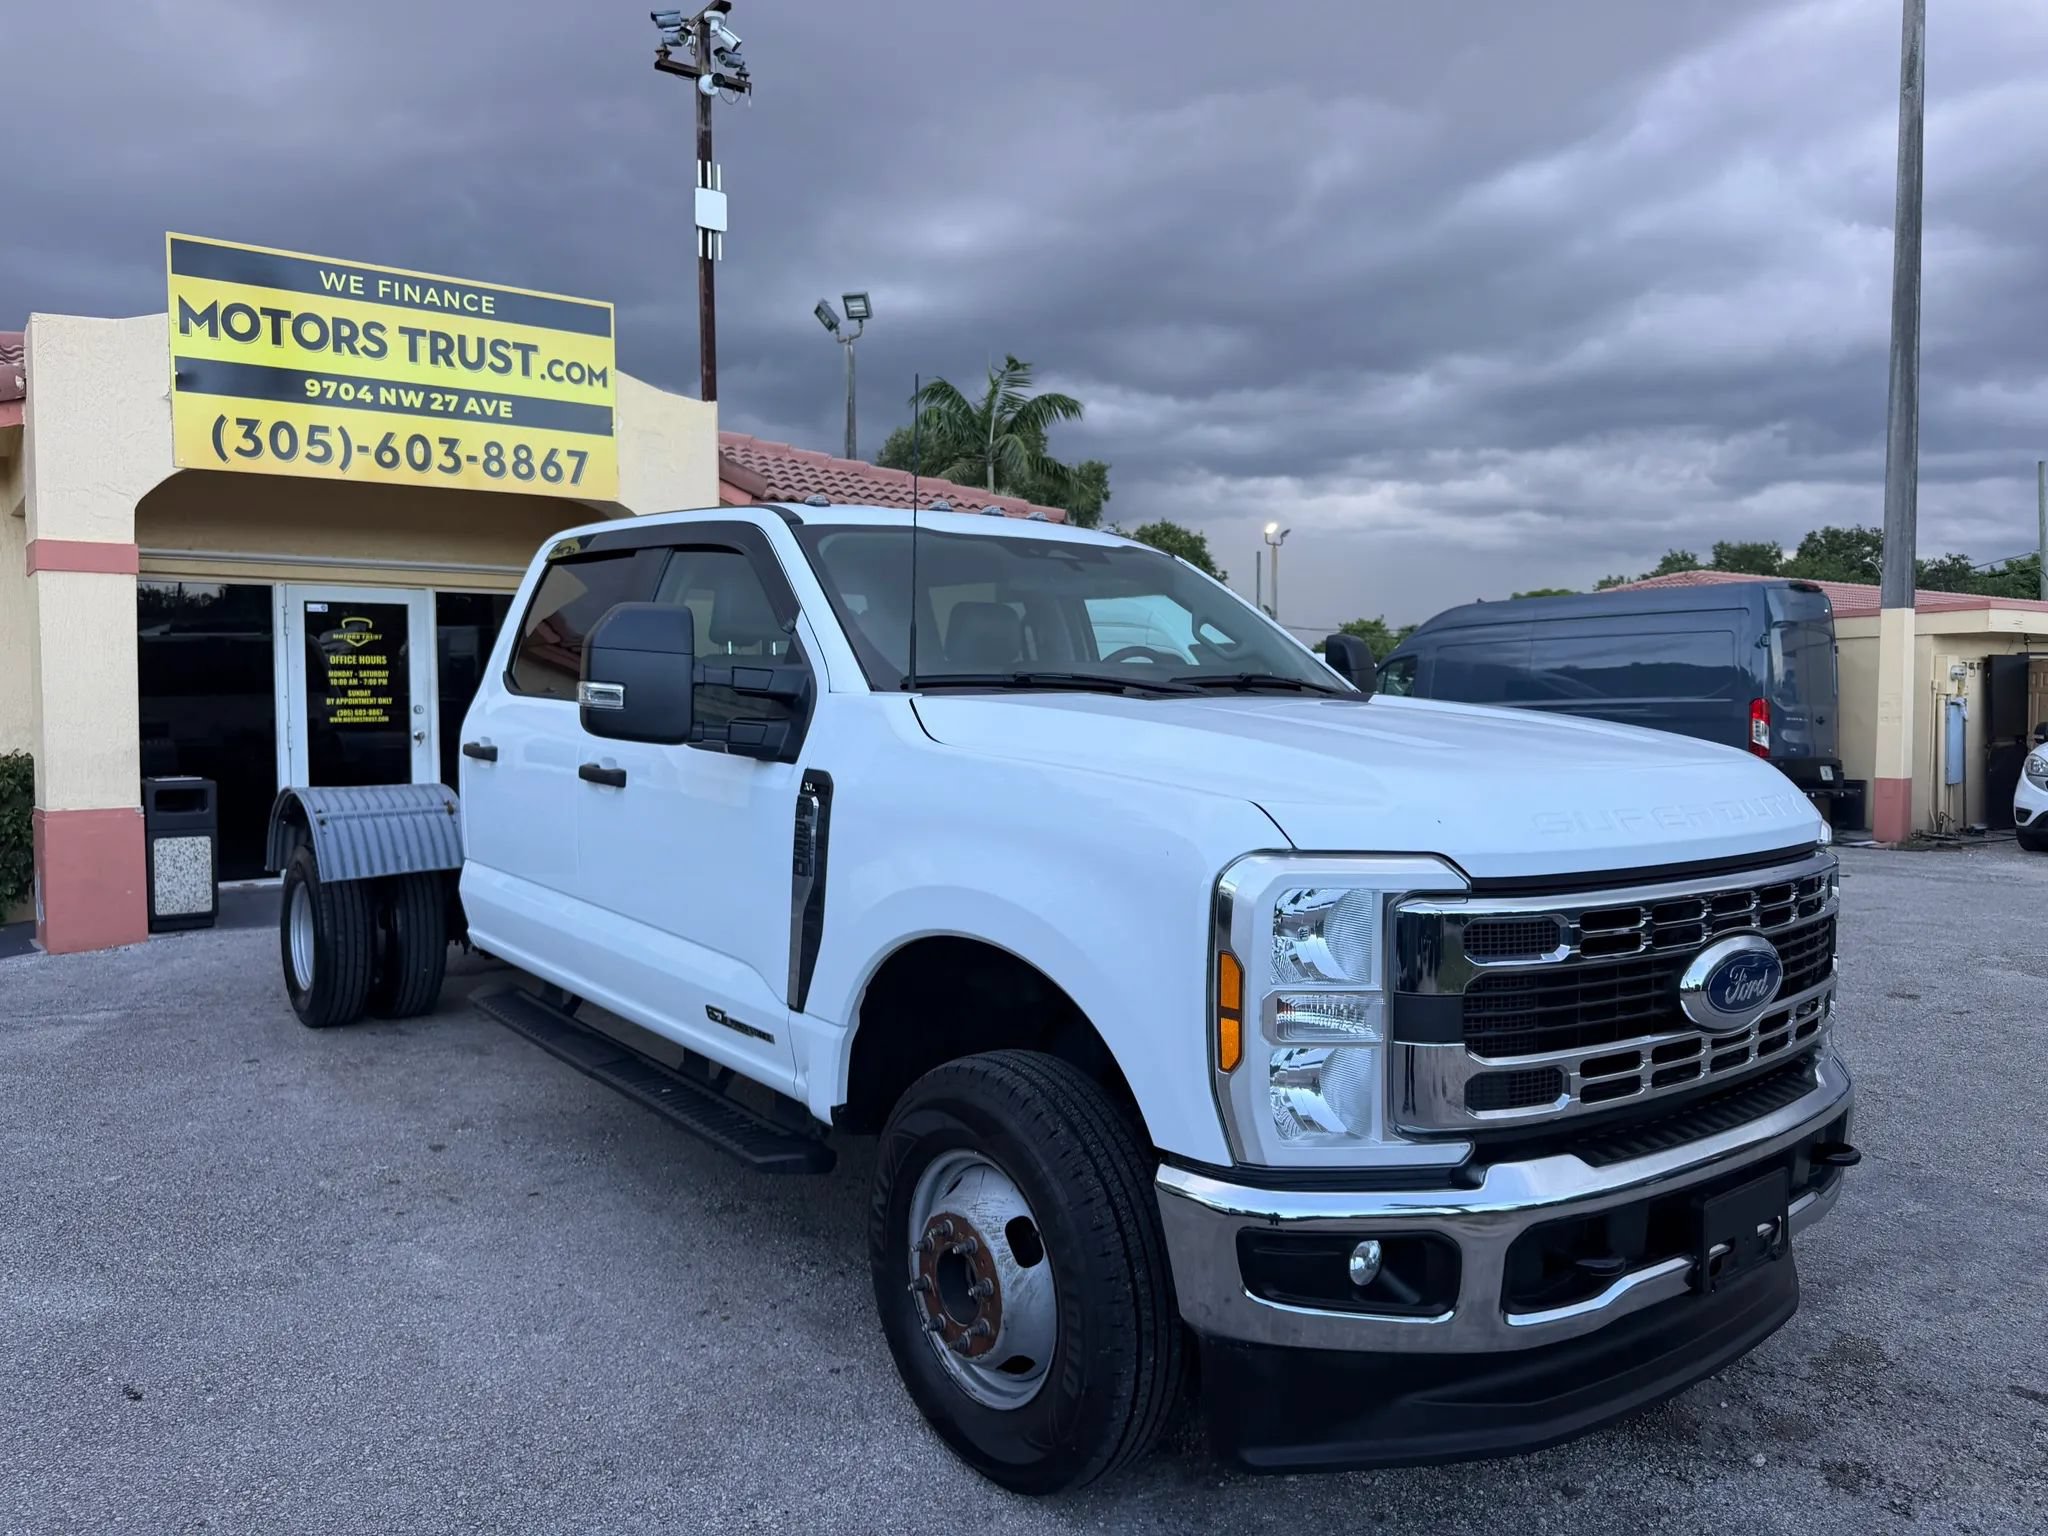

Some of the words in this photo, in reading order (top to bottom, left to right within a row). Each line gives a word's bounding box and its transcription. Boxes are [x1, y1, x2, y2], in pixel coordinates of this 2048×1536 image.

[319, 269, 365, 295] WE
[378, 279, 496, 315] FINANCE
[178, 294, 389, 360] MOTORS
[304, 378, 374, 404] 9704
[379, 391, 425, 409] NW
[430, 396, 458, 413] 27
[463, 398, 513, 419] AVE
[211, 413, 589, 487] (305)-603-8867
[330, 656, 357, 664] OFFICE
[359, 656, 387, 664] HOURS
[378, 697, 392, 705] ONLY
[1725, 961, 1769, 1005] Ford
